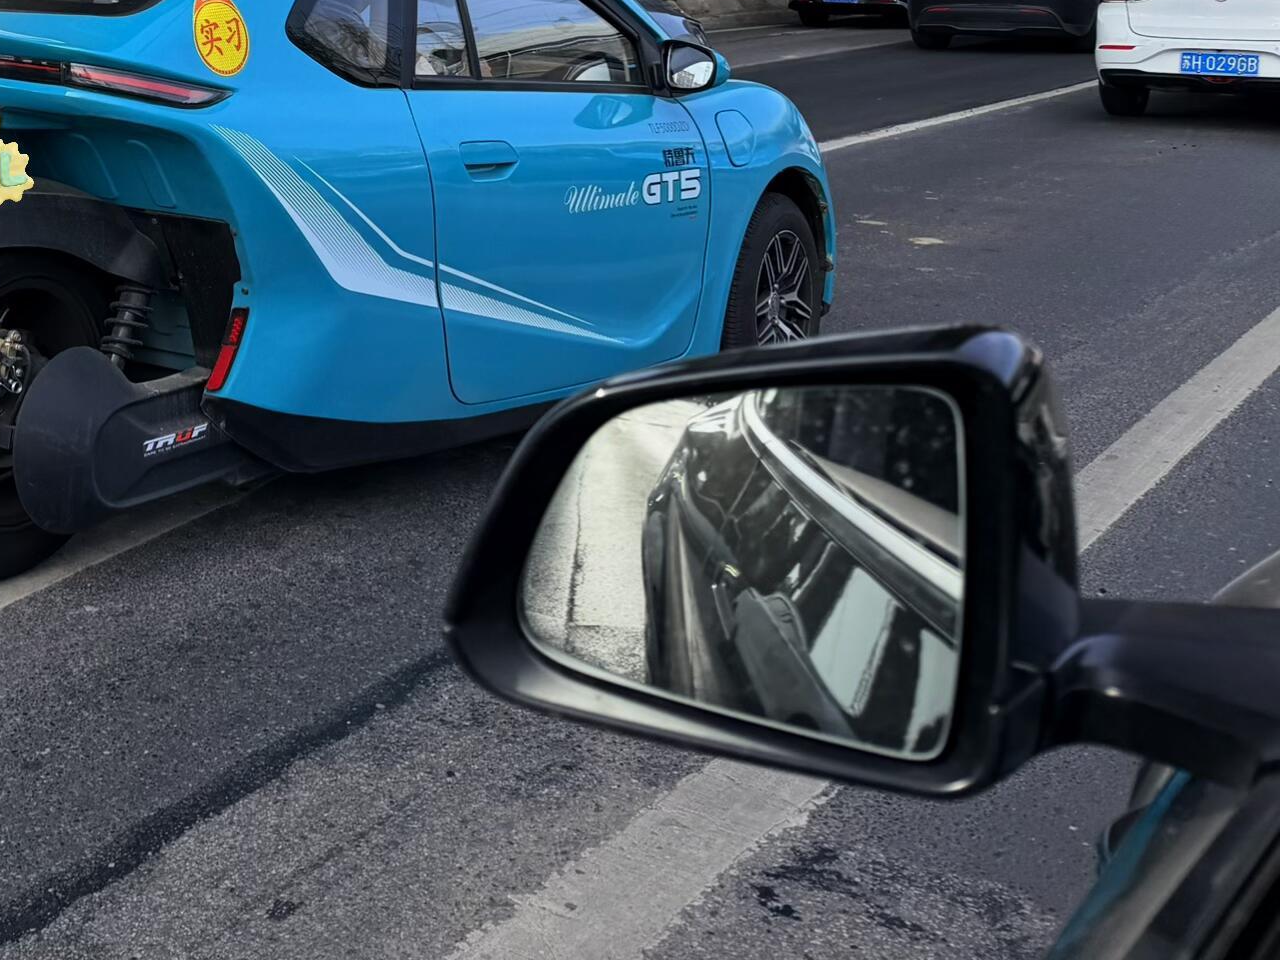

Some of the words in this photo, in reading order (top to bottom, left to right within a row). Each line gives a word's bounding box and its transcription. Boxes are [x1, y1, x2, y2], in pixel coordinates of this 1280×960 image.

[200, 17, 242, 57] 实习
[662, 147, 696, 167] 特鲁夫
[564, 181, 640, 214] Ultimate
